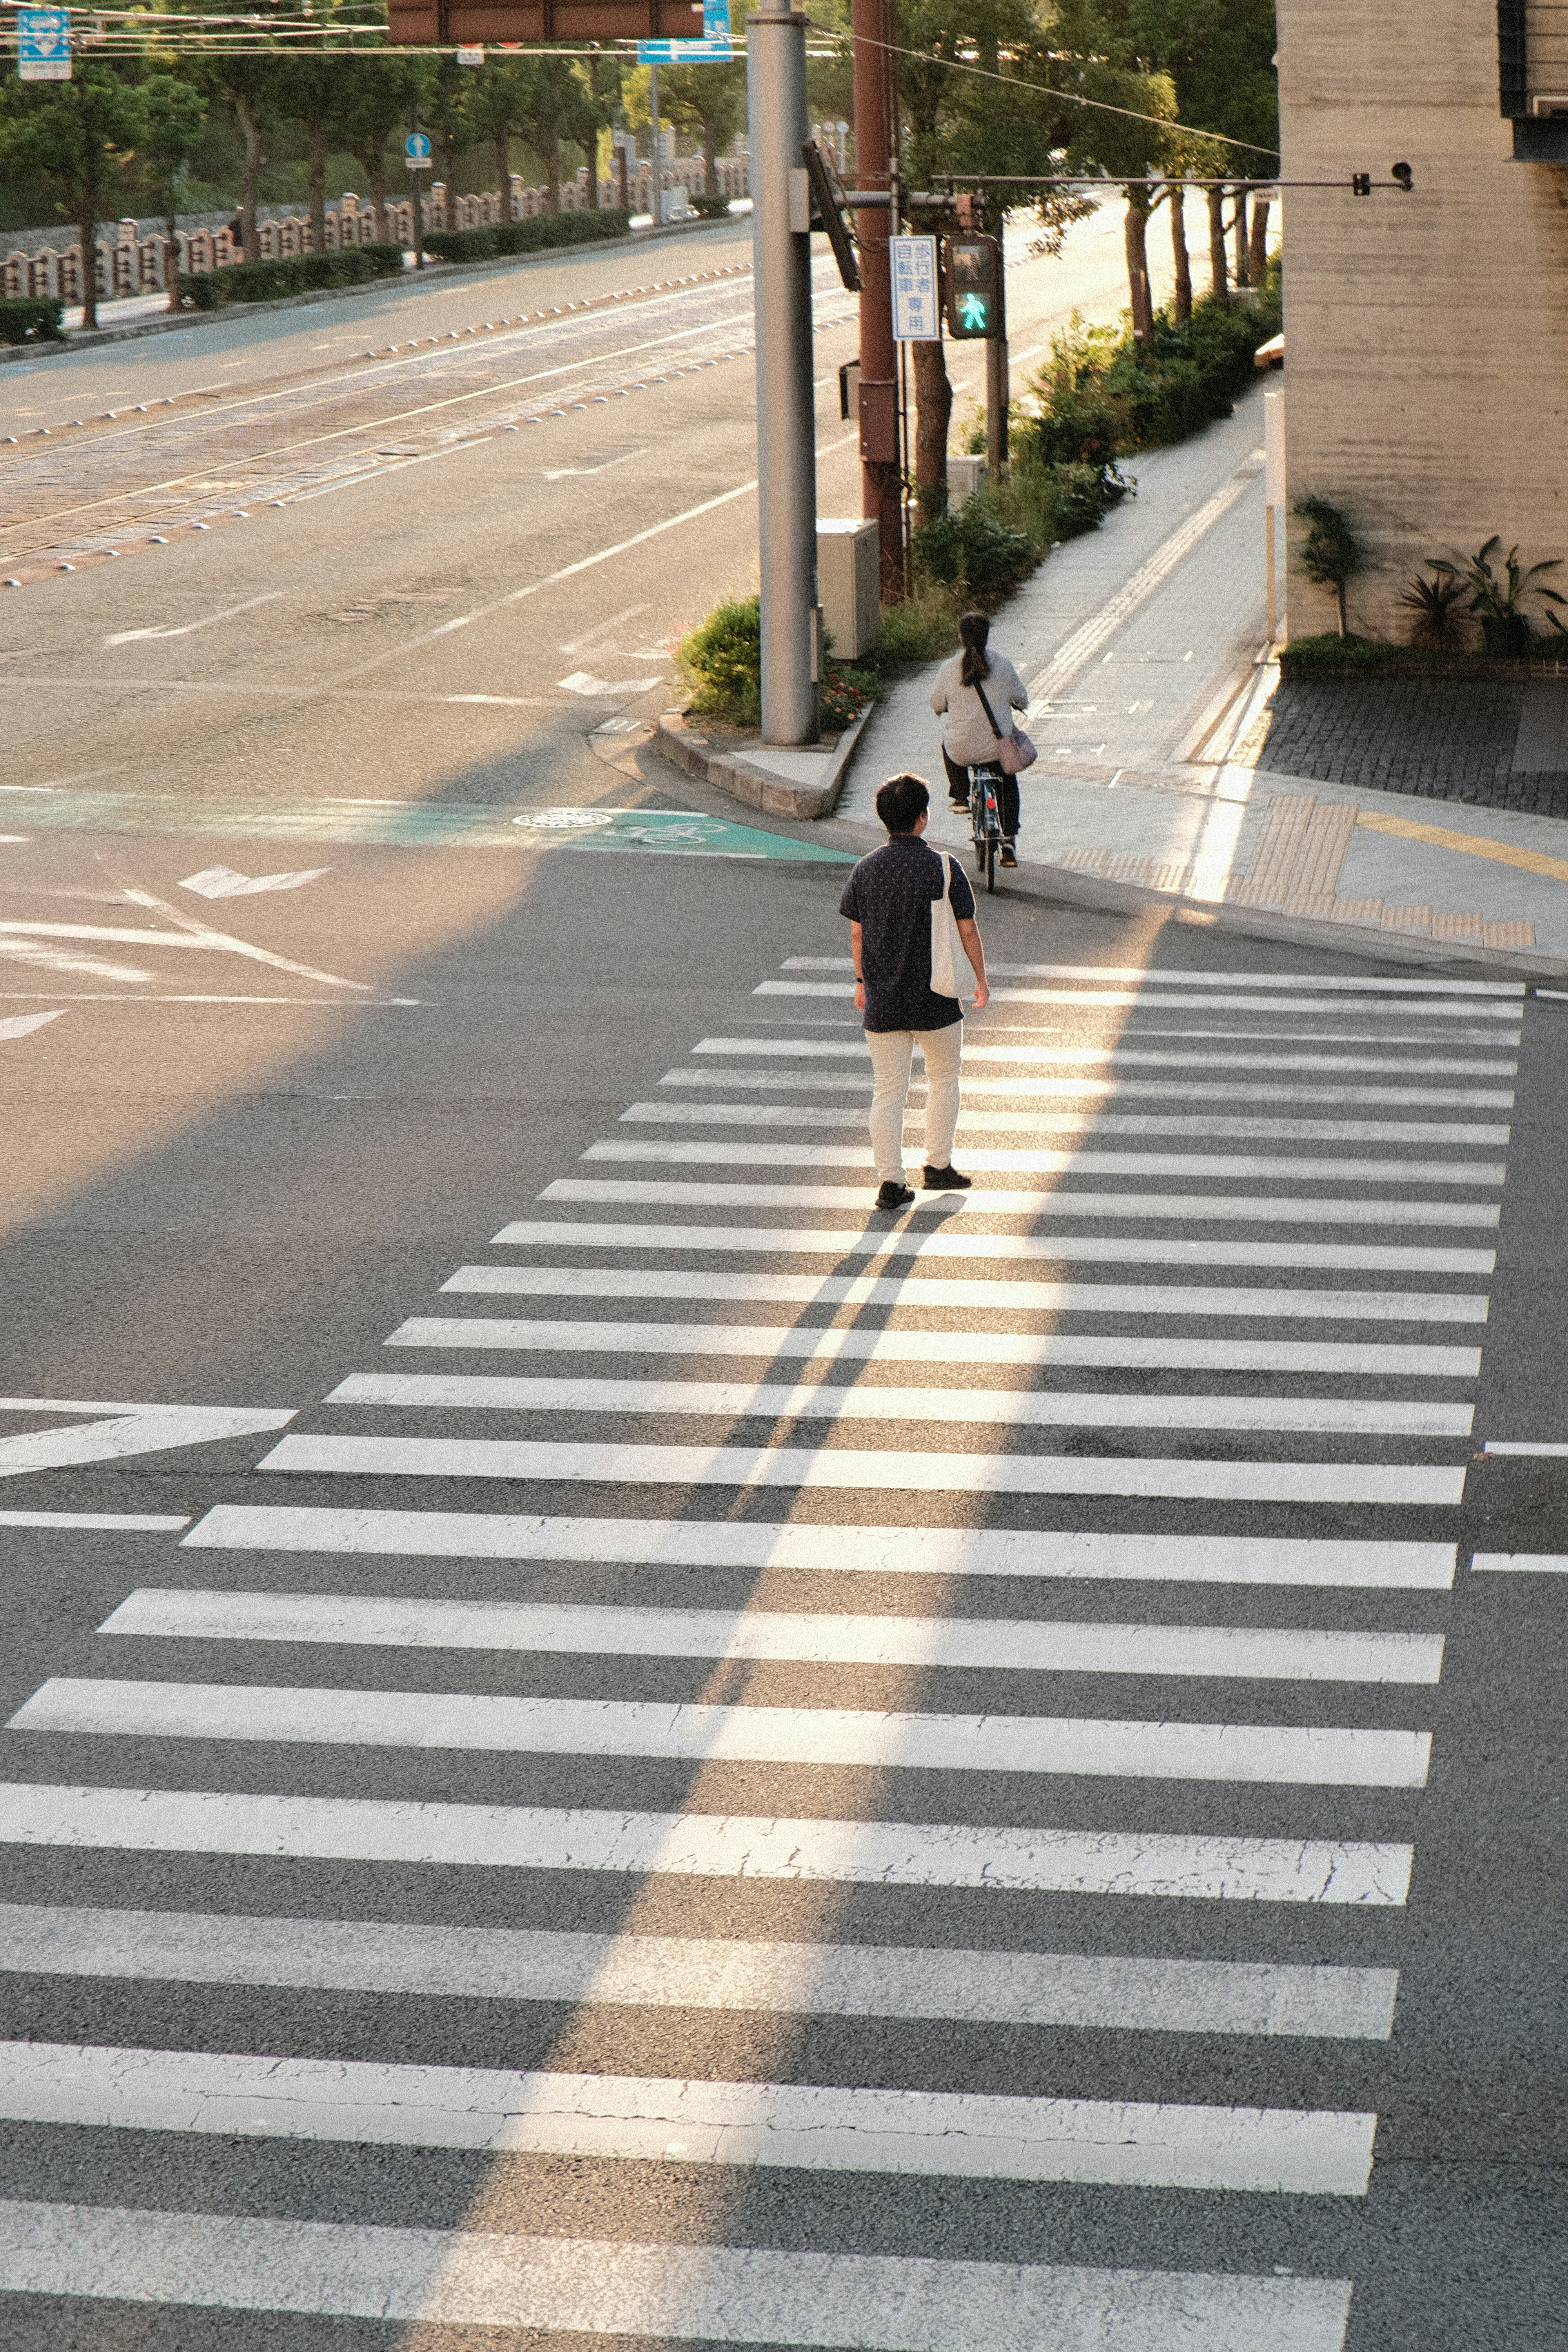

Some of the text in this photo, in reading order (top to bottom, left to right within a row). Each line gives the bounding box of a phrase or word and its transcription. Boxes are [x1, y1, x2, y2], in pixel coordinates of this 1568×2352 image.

[898, 244, 913, 292] 自転車
[915, 244, 931, 292] 歩行者
[908, 297, 923, 331] 専用
